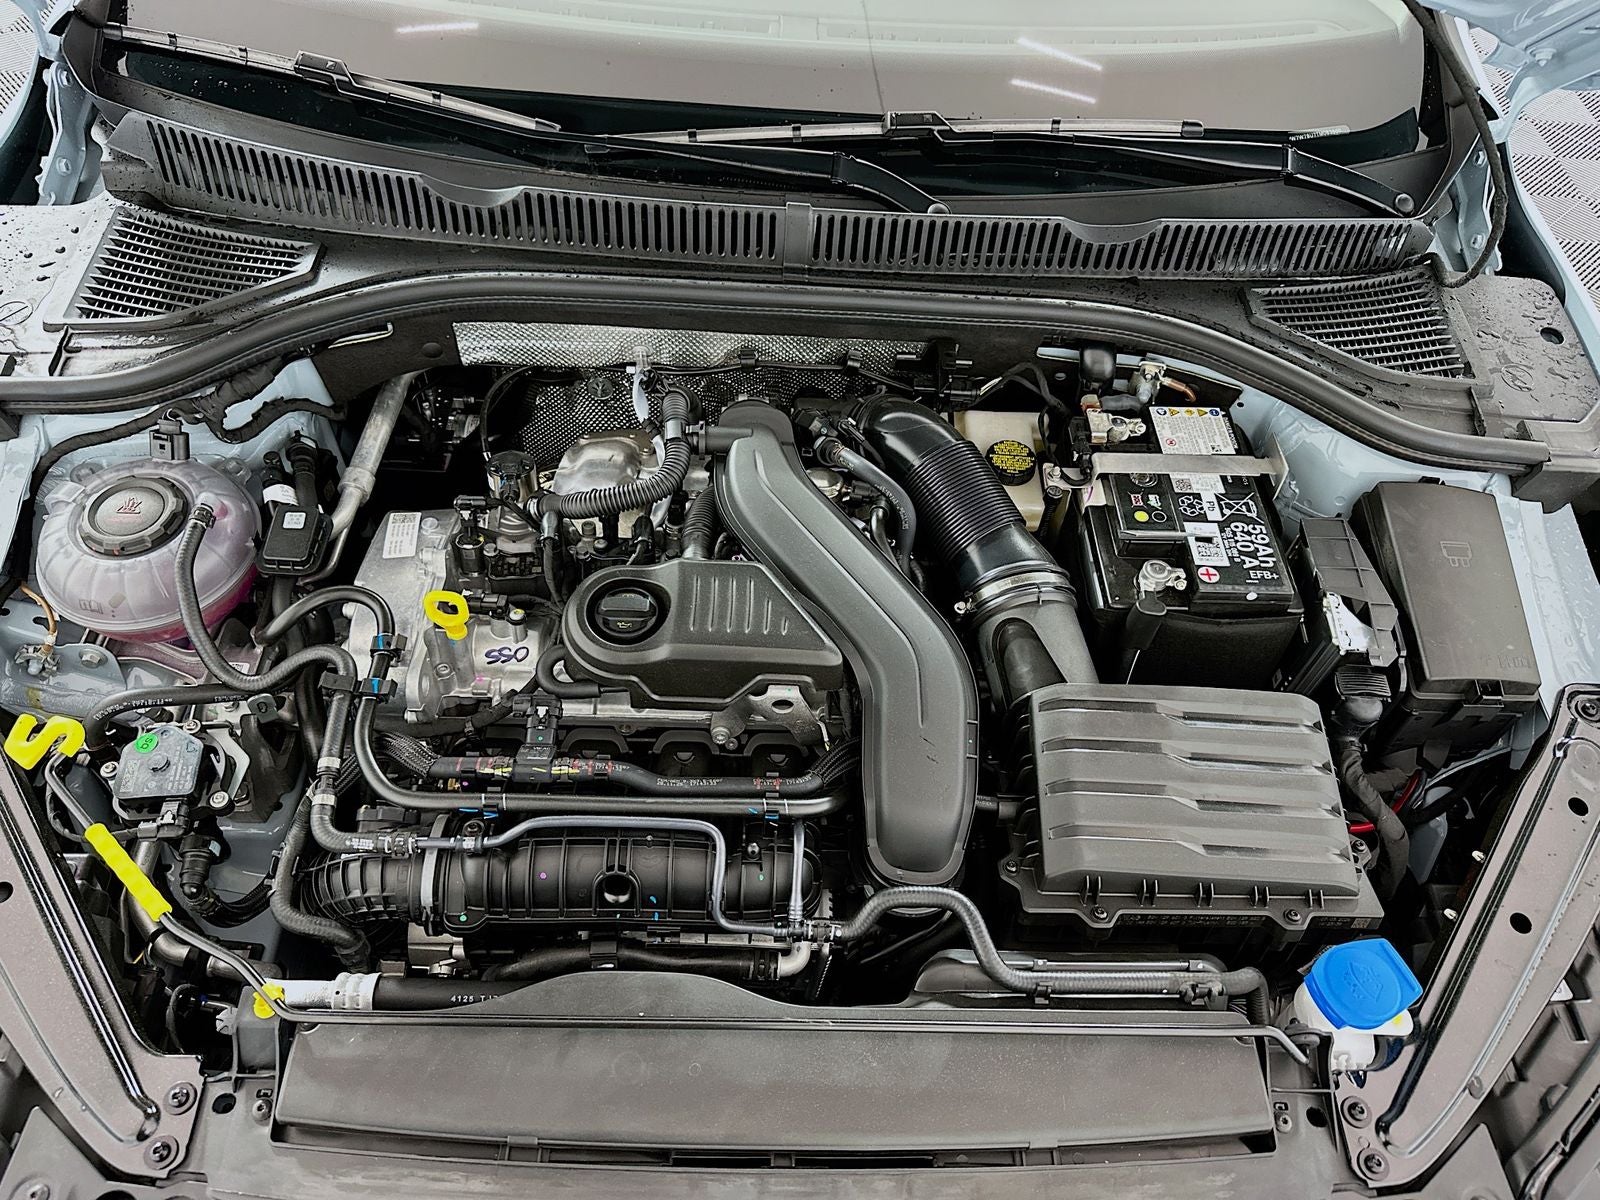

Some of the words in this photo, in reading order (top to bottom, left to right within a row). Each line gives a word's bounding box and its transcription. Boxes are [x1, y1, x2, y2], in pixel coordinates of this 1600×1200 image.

[1206, 501, 1215, 512] Pb
[1230, 522, 1255, 552] 640
[1248, 524, 1277, 568] 59Ah
[1240, 555, 1260, 569] A
[1250, 570, 1279, 580] EFB+
[450, 994, 474, 1003] 4125
